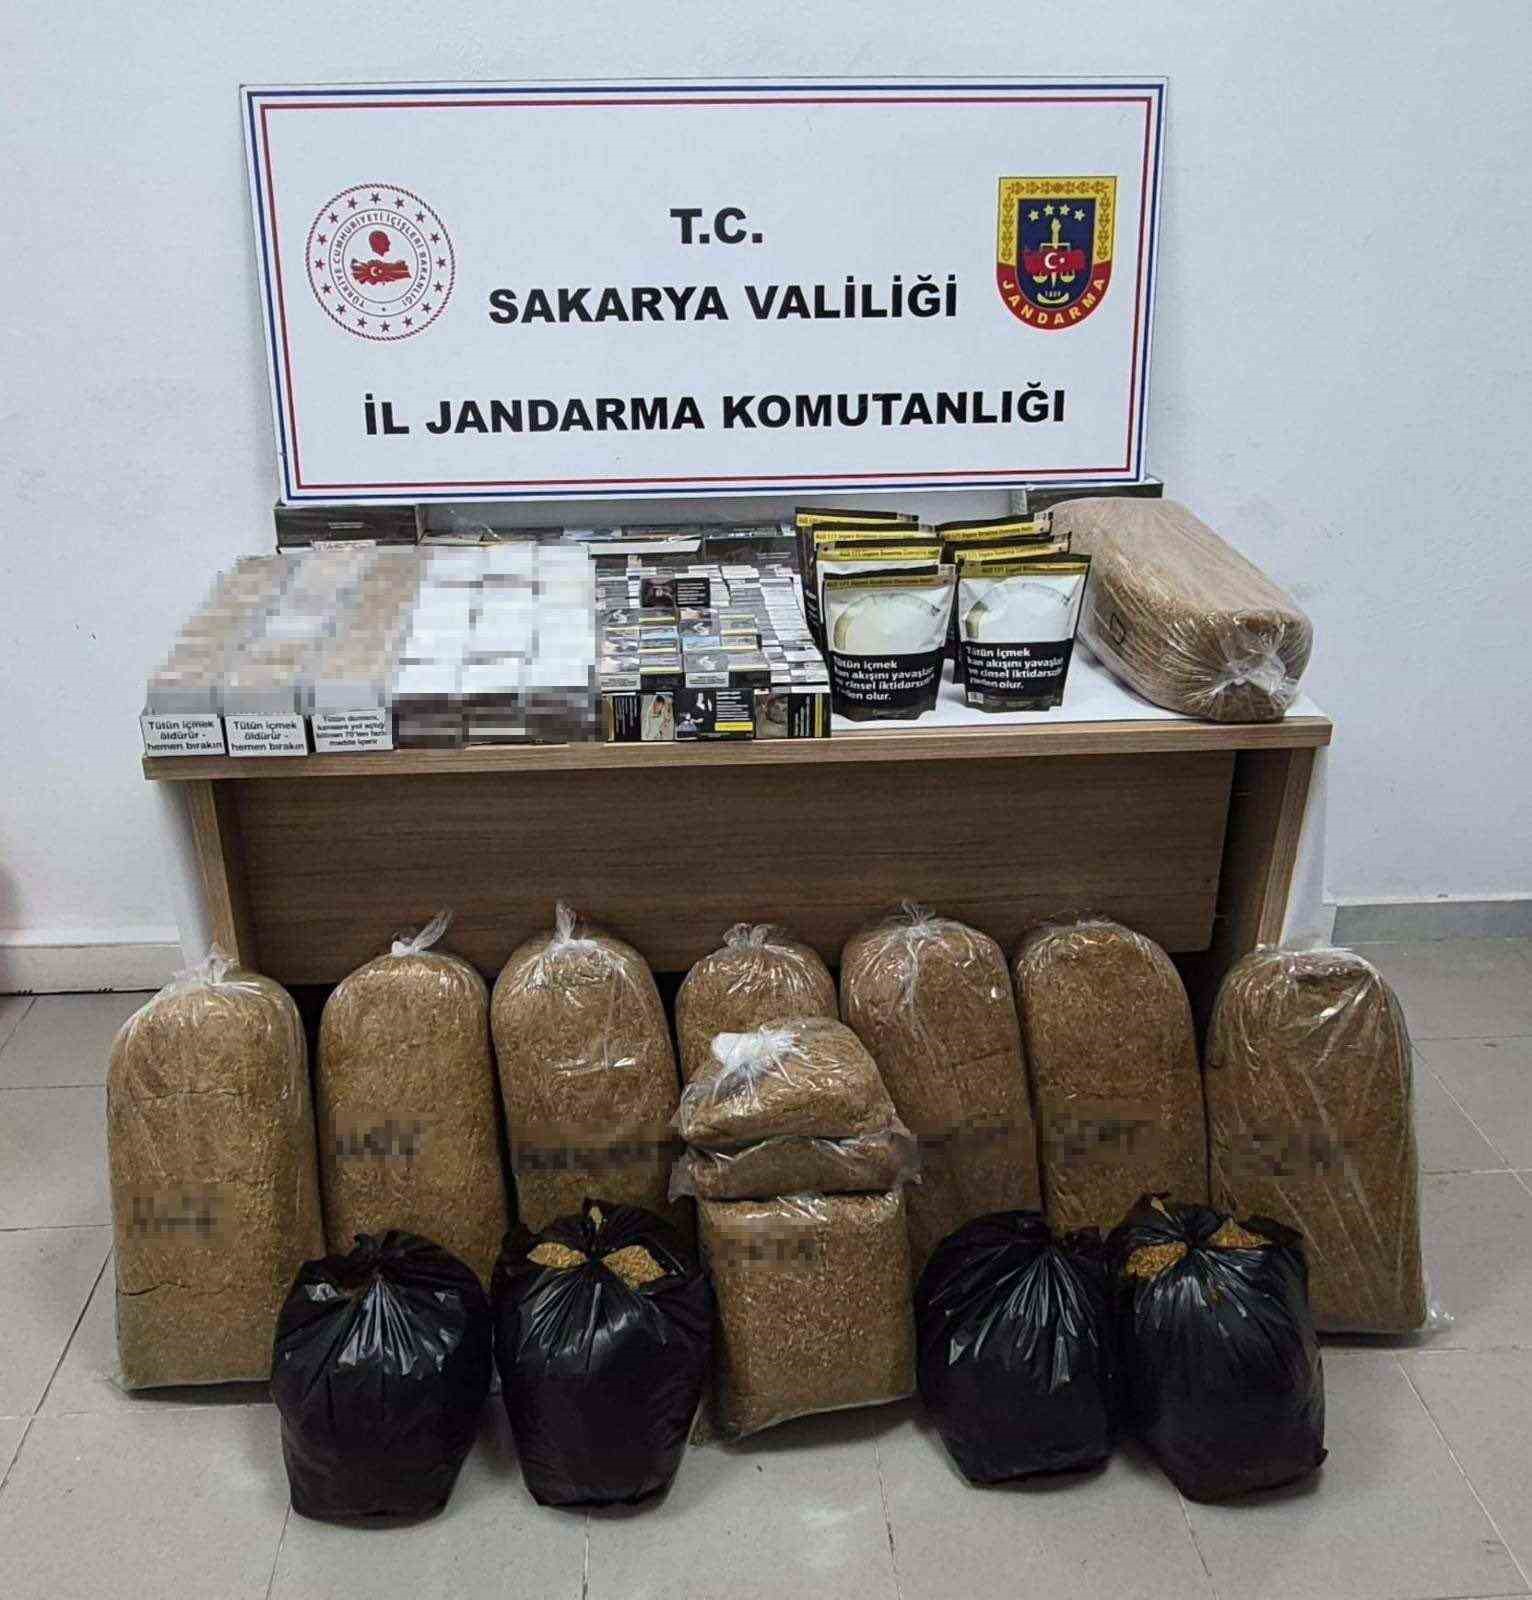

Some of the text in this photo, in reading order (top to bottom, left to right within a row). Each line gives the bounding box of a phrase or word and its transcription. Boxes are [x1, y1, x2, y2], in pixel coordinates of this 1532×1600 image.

[670, 208, 763, 245] T.C.
[489, 275, 957, 324] SAKARYA VALİLİĞİ
[1002, 280, 1105, 325] JANDARMA
[365, 382, 1065, 435] İL JANDARMA KOMUTANLIĞI
[148, 720, 214, 731] Tütün içmek
[233, 720, 297, 731] Tütün içmek
[147, 740, 223, 751] hemen bırakın
[231, 742, 304, 751] hemen bırakın
